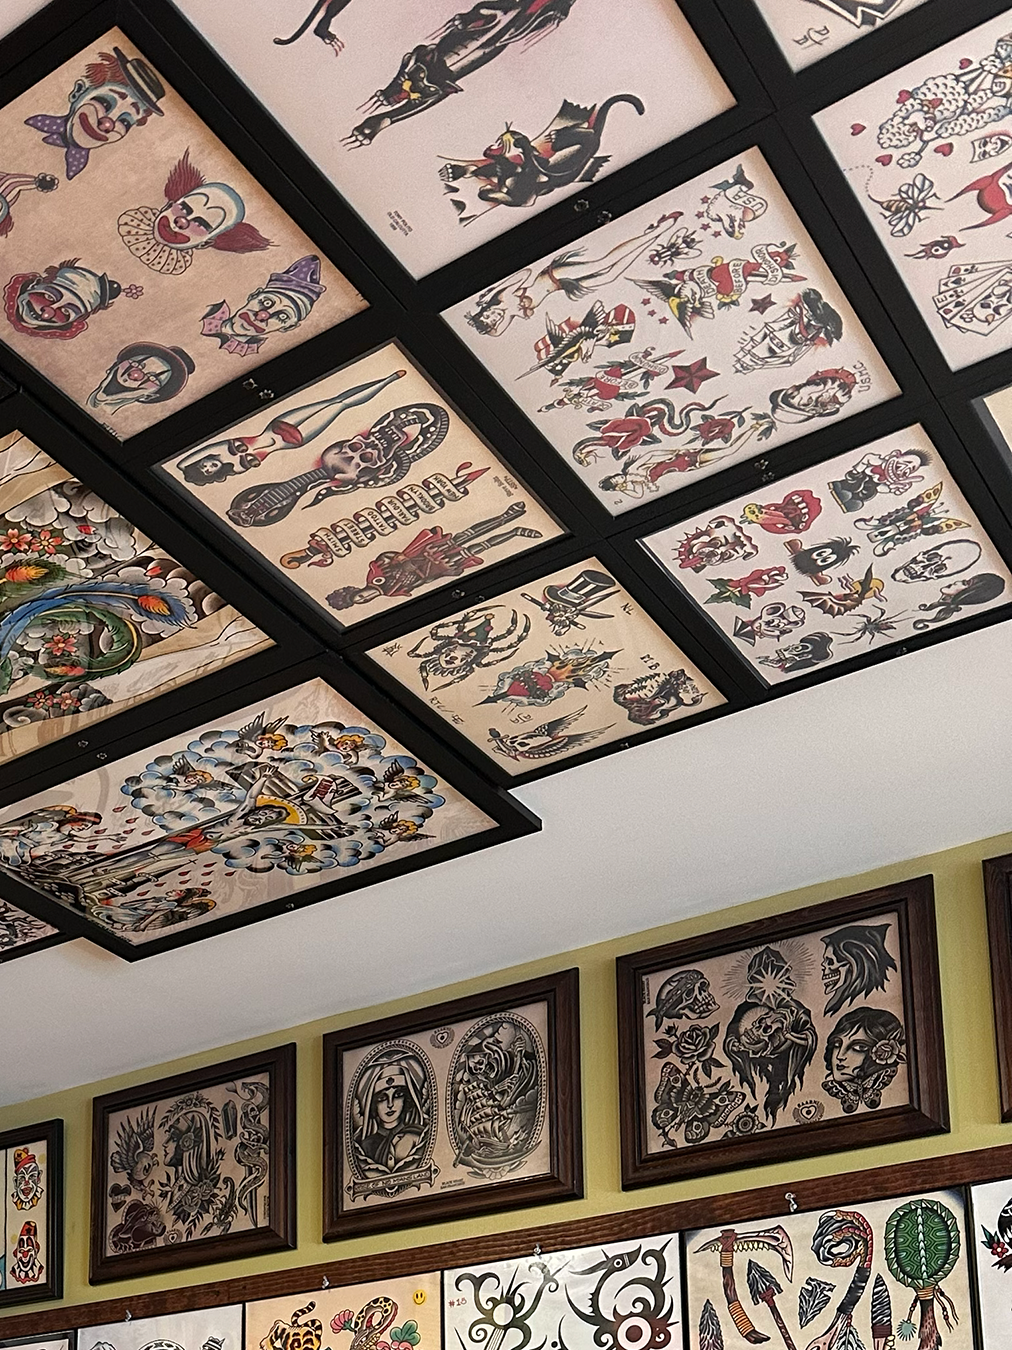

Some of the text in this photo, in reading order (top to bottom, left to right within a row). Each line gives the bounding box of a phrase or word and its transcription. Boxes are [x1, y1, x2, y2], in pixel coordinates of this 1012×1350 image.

[733, 190, 764, 214] USA
[755, 247, 780, 283] DISHONOR
[695, 269, 715, 295] DEATH
[733, 262, 742, 293] BEFORE
[387, 499, 411, 522] PARLOUR
[408, 486, 435, 511] BROOKLYN
[343, 522, 365, 543] STREET
[367, 511, 387, 532] TATTOO
[324, 532, 342, 552] SMITH
